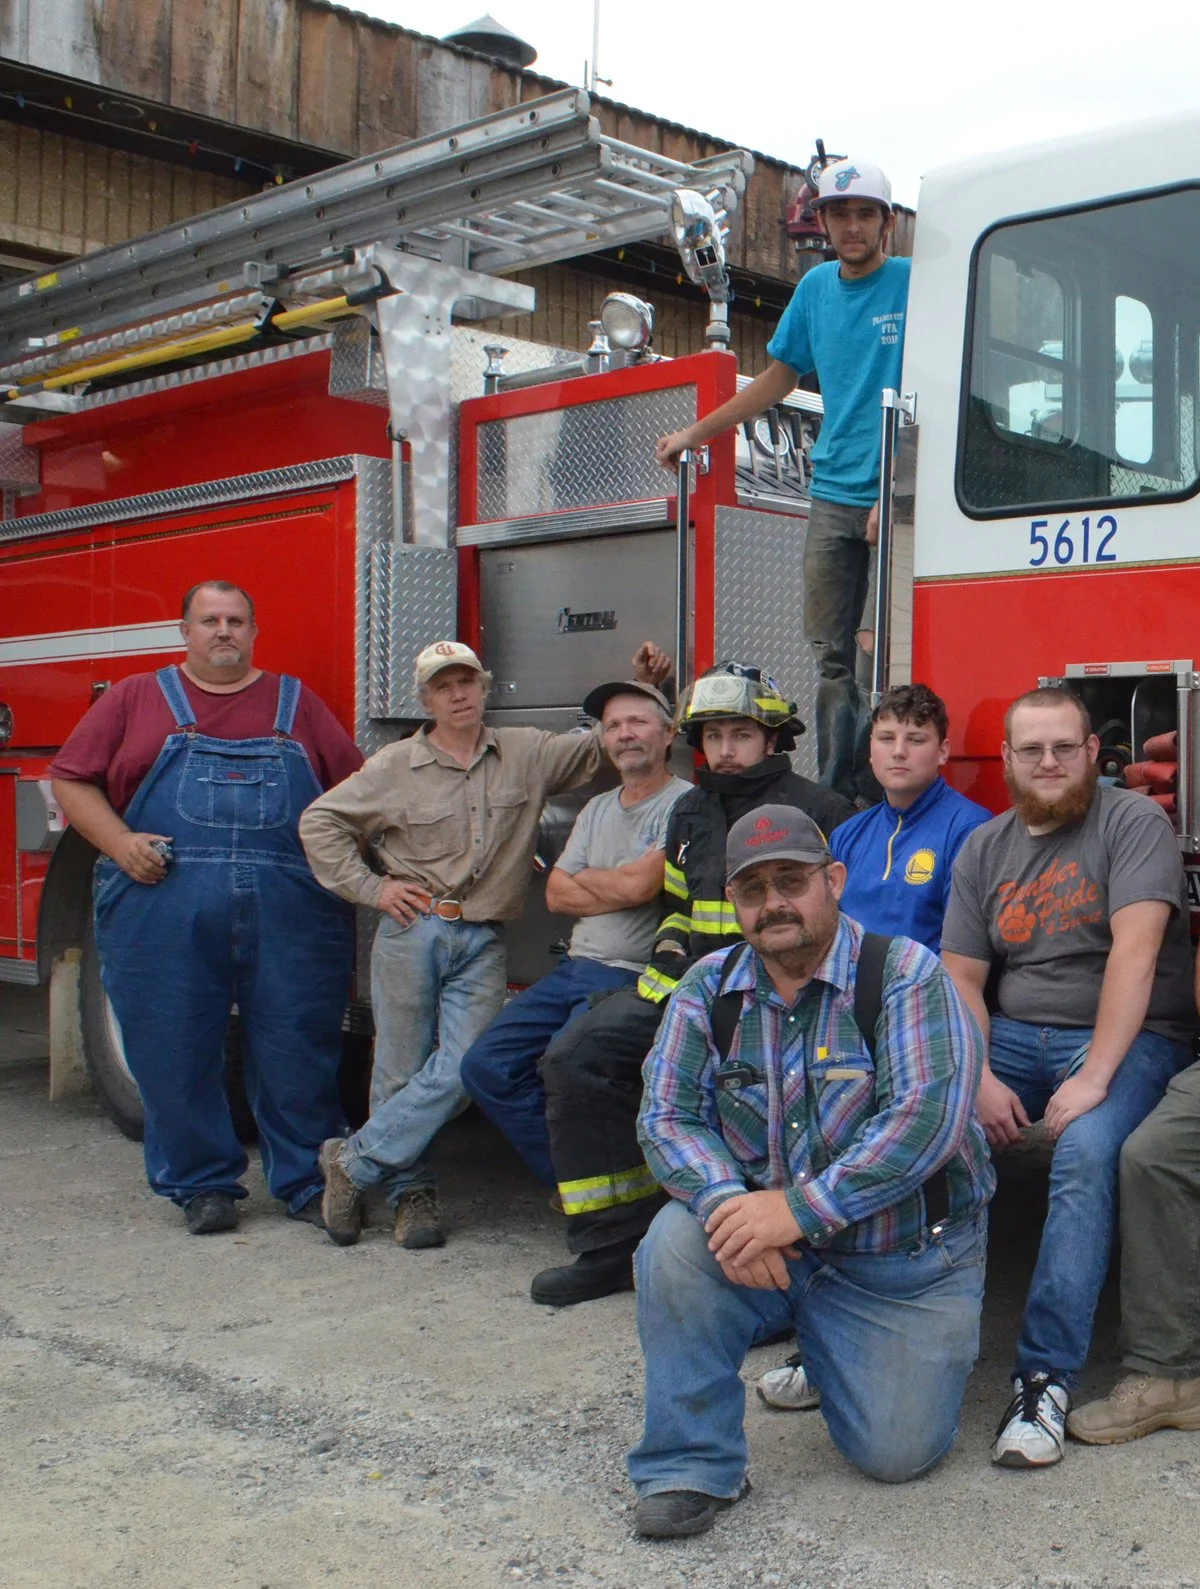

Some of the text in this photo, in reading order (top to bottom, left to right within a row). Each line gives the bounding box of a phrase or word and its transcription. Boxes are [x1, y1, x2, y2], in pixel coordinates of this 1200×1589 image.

[1029, 515, 1117, 566] 5612
[998, 858, 1078, 904] Panther
[1033, 877, 1098, 928] Pride
